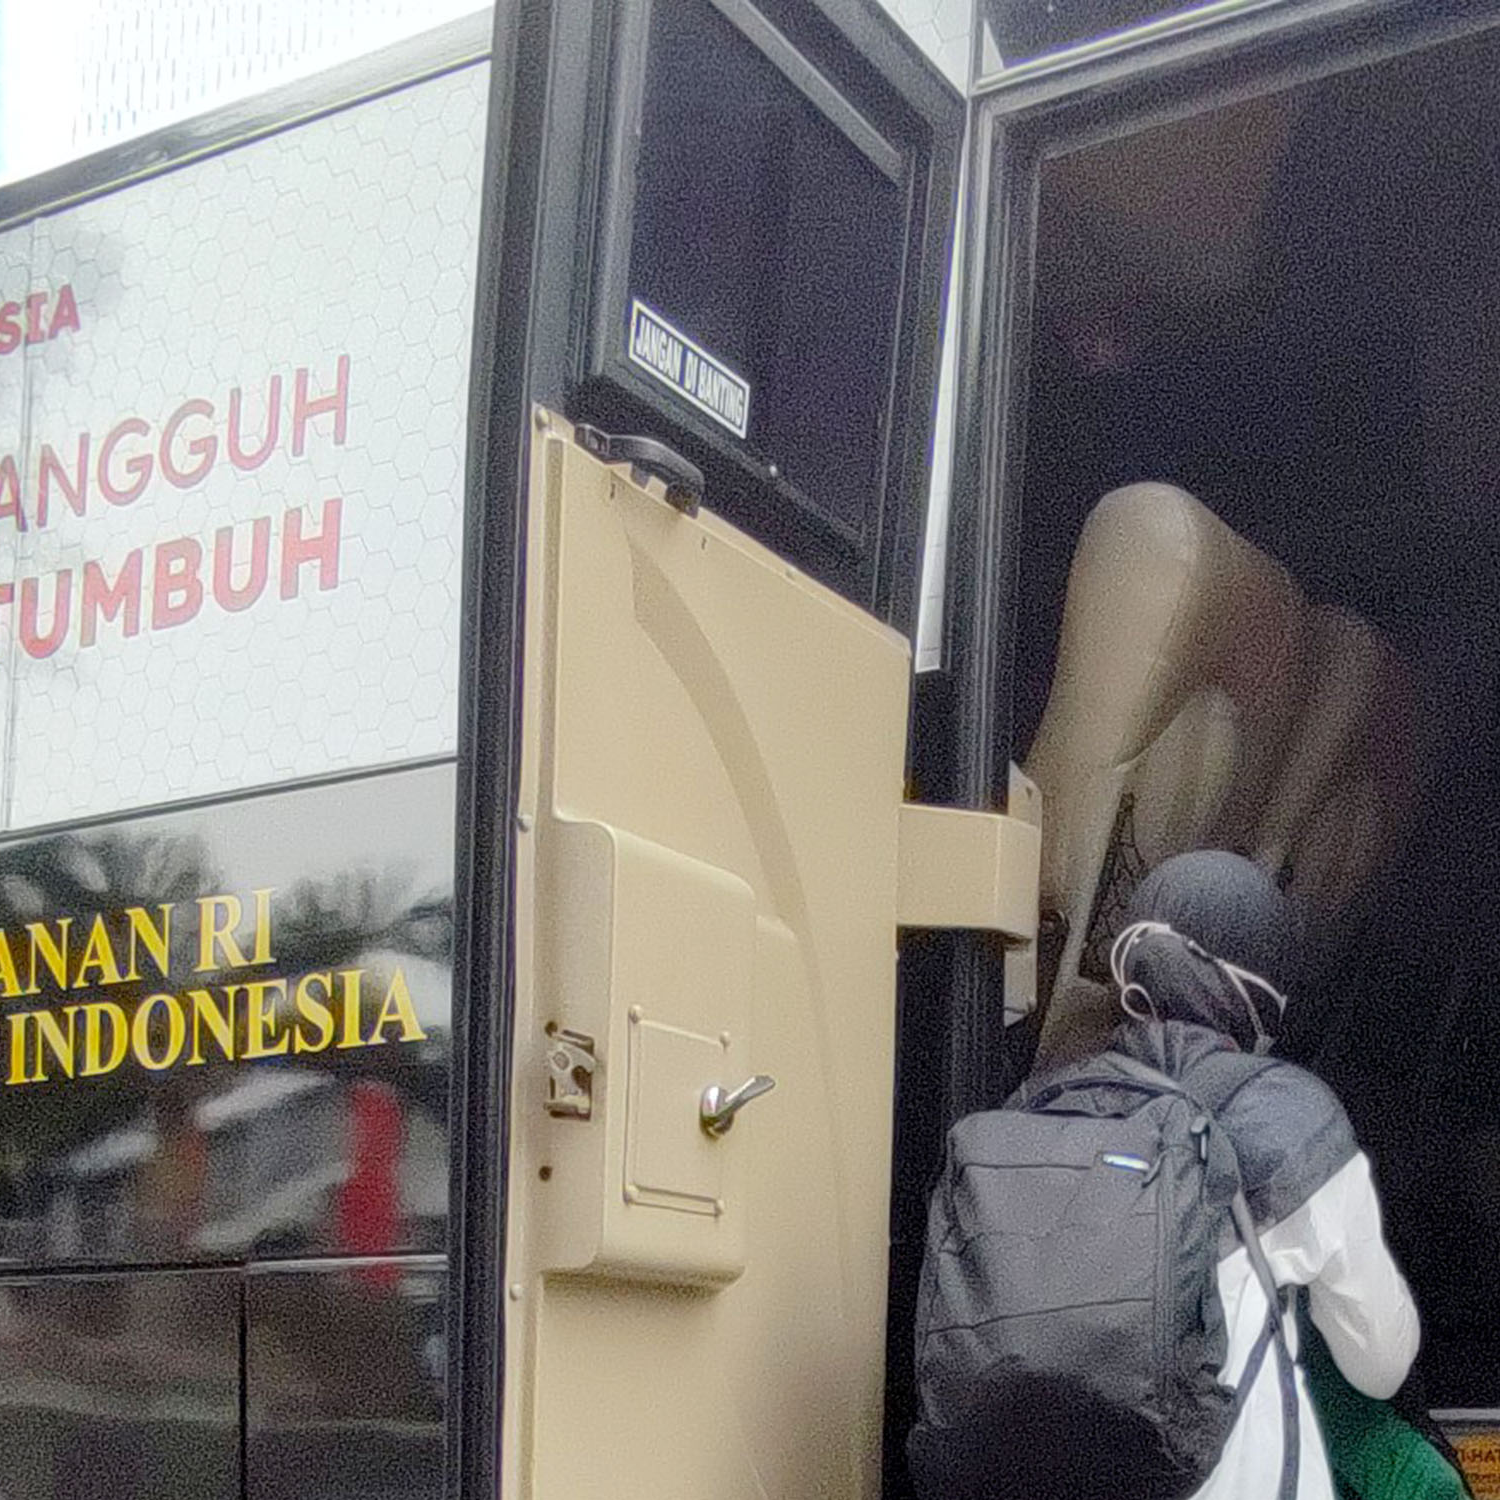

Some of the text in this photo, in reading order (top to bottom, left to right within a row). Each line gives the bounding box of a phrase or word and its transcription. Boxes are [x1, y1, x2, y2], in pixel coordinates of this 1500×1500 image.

[635, 316, 744, 426] JANGAN DI BANTING
[194, 888, 277, 970] RI
[4, 965, 427, 1086] INDONESIA
